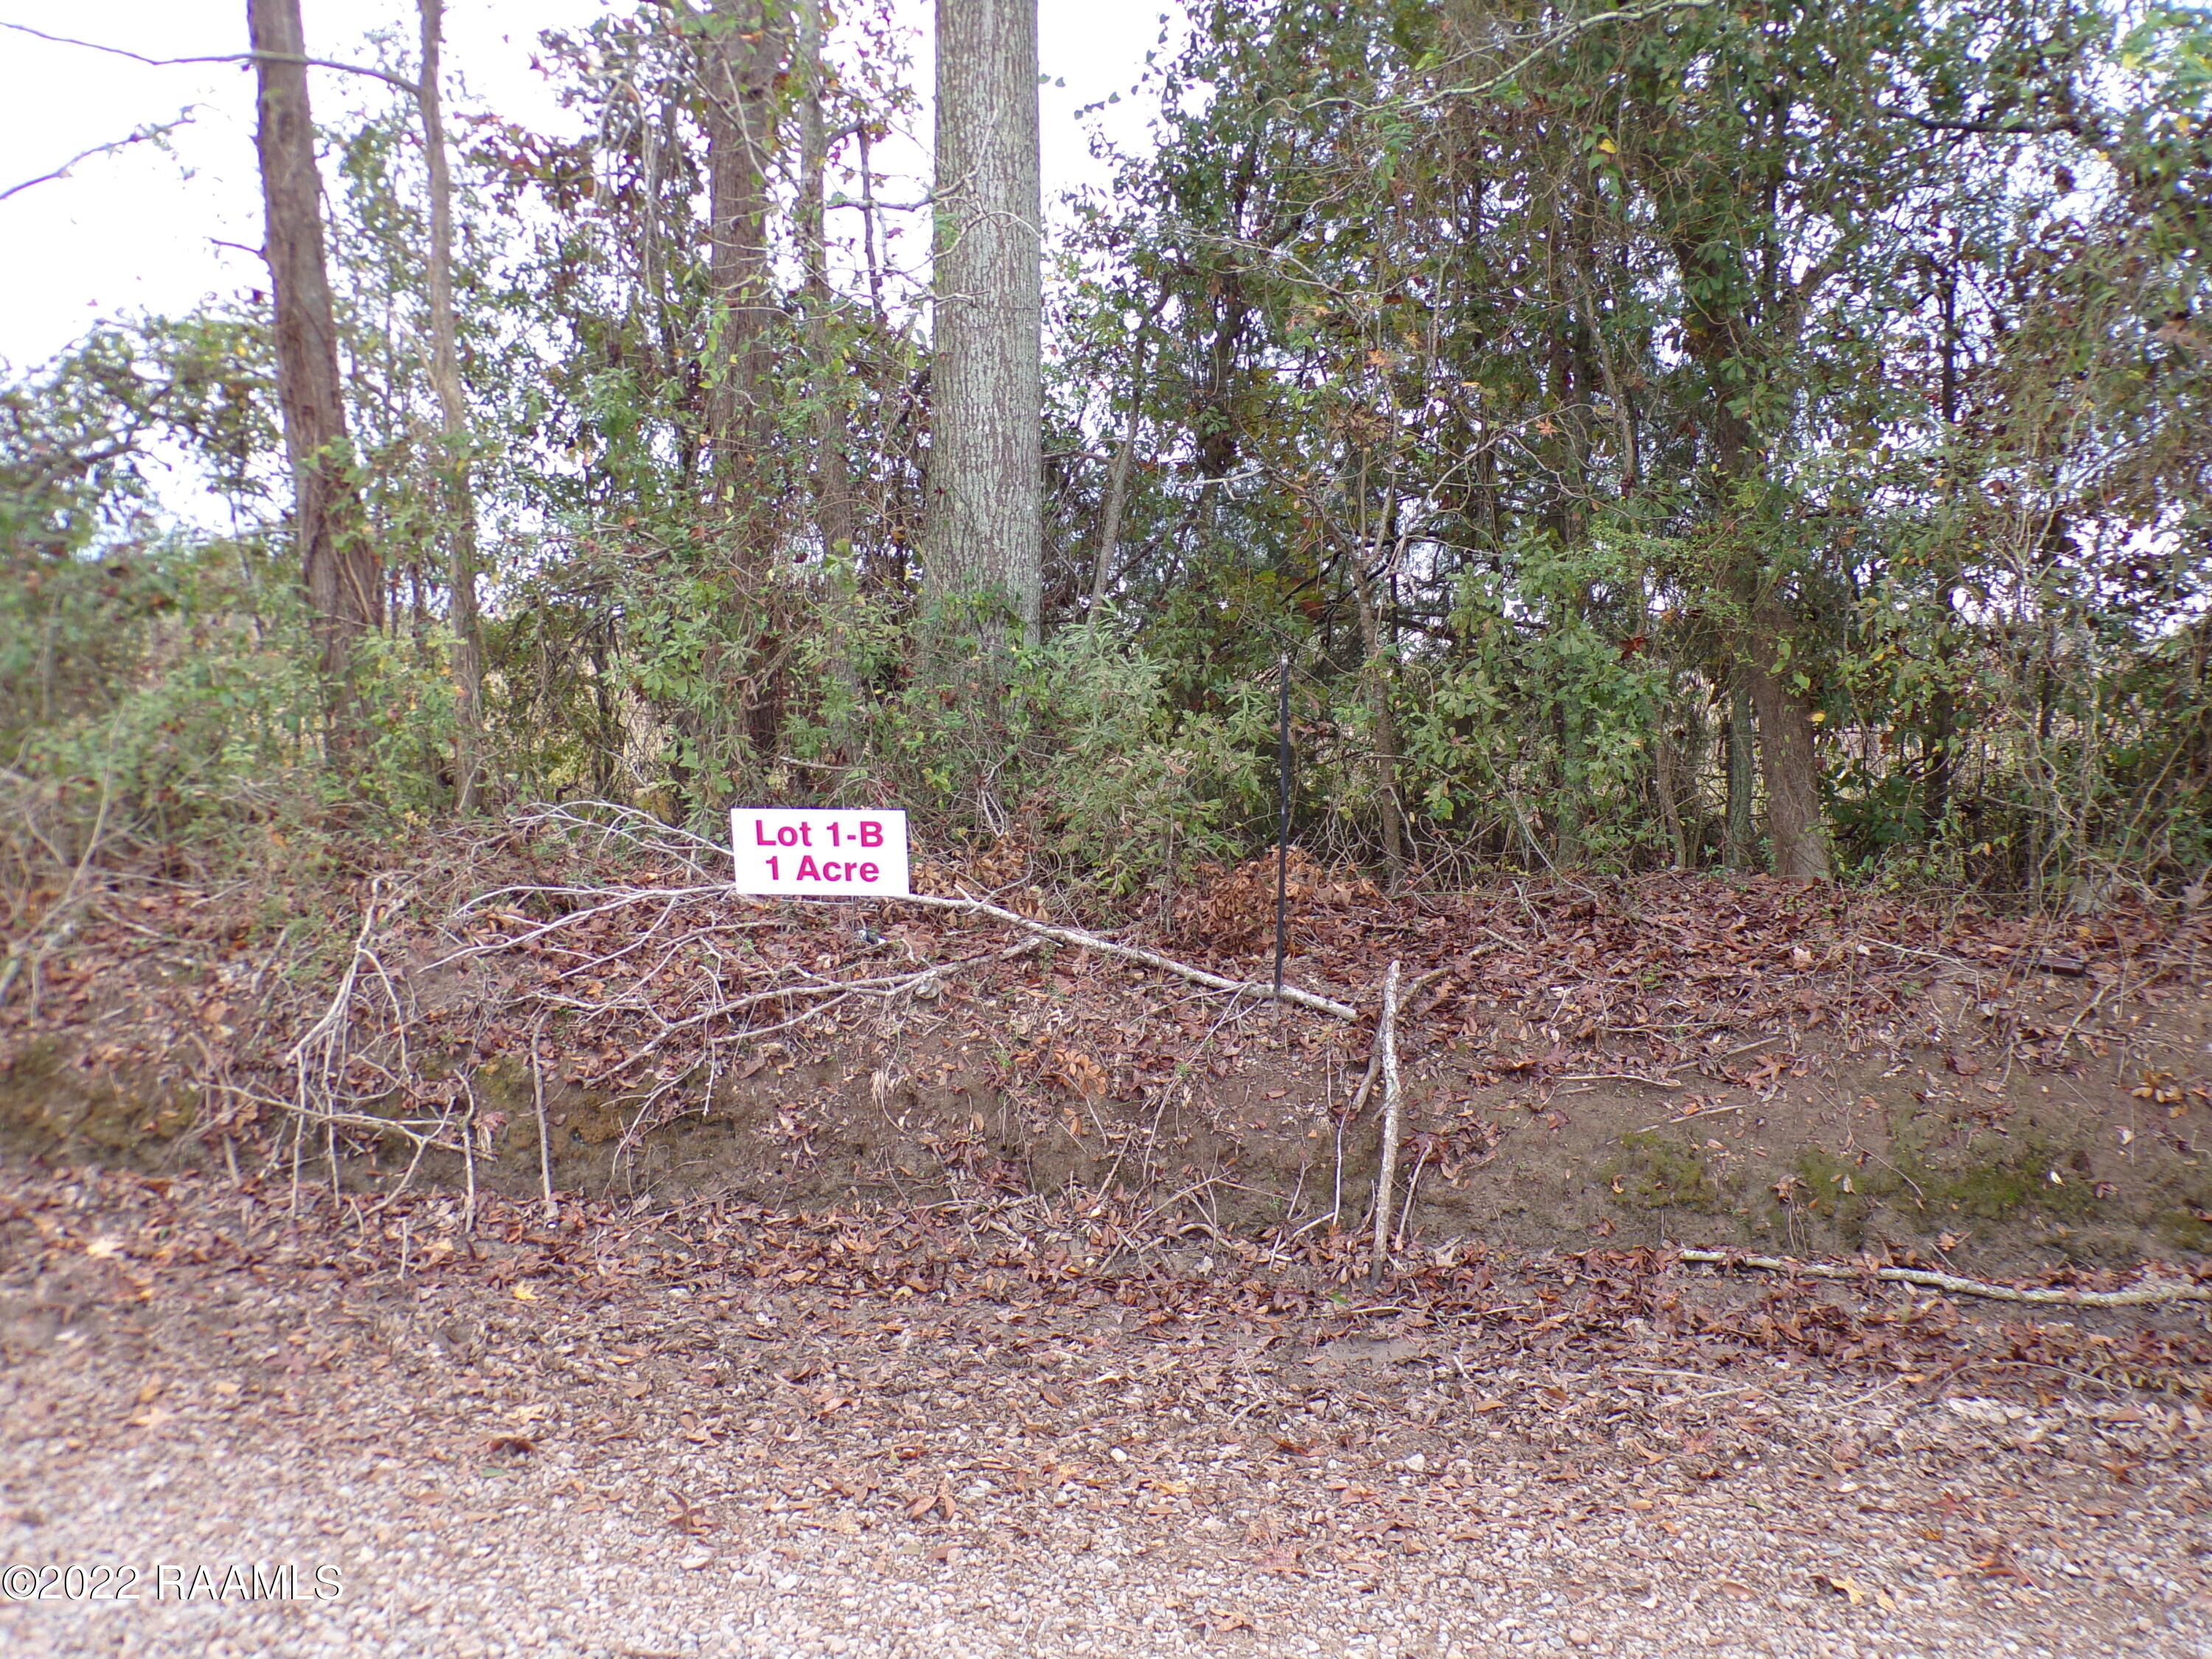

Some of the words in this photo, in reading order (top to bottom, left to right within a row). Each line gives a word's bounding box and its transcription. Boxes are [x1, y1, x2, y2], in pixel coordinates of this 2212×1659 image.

[755, 819, 813, 847] Lot
[826, 821, 884, 848] 1-B
[765, 855, 780, 881] 1
[796, 855, 880, 883] Acre
